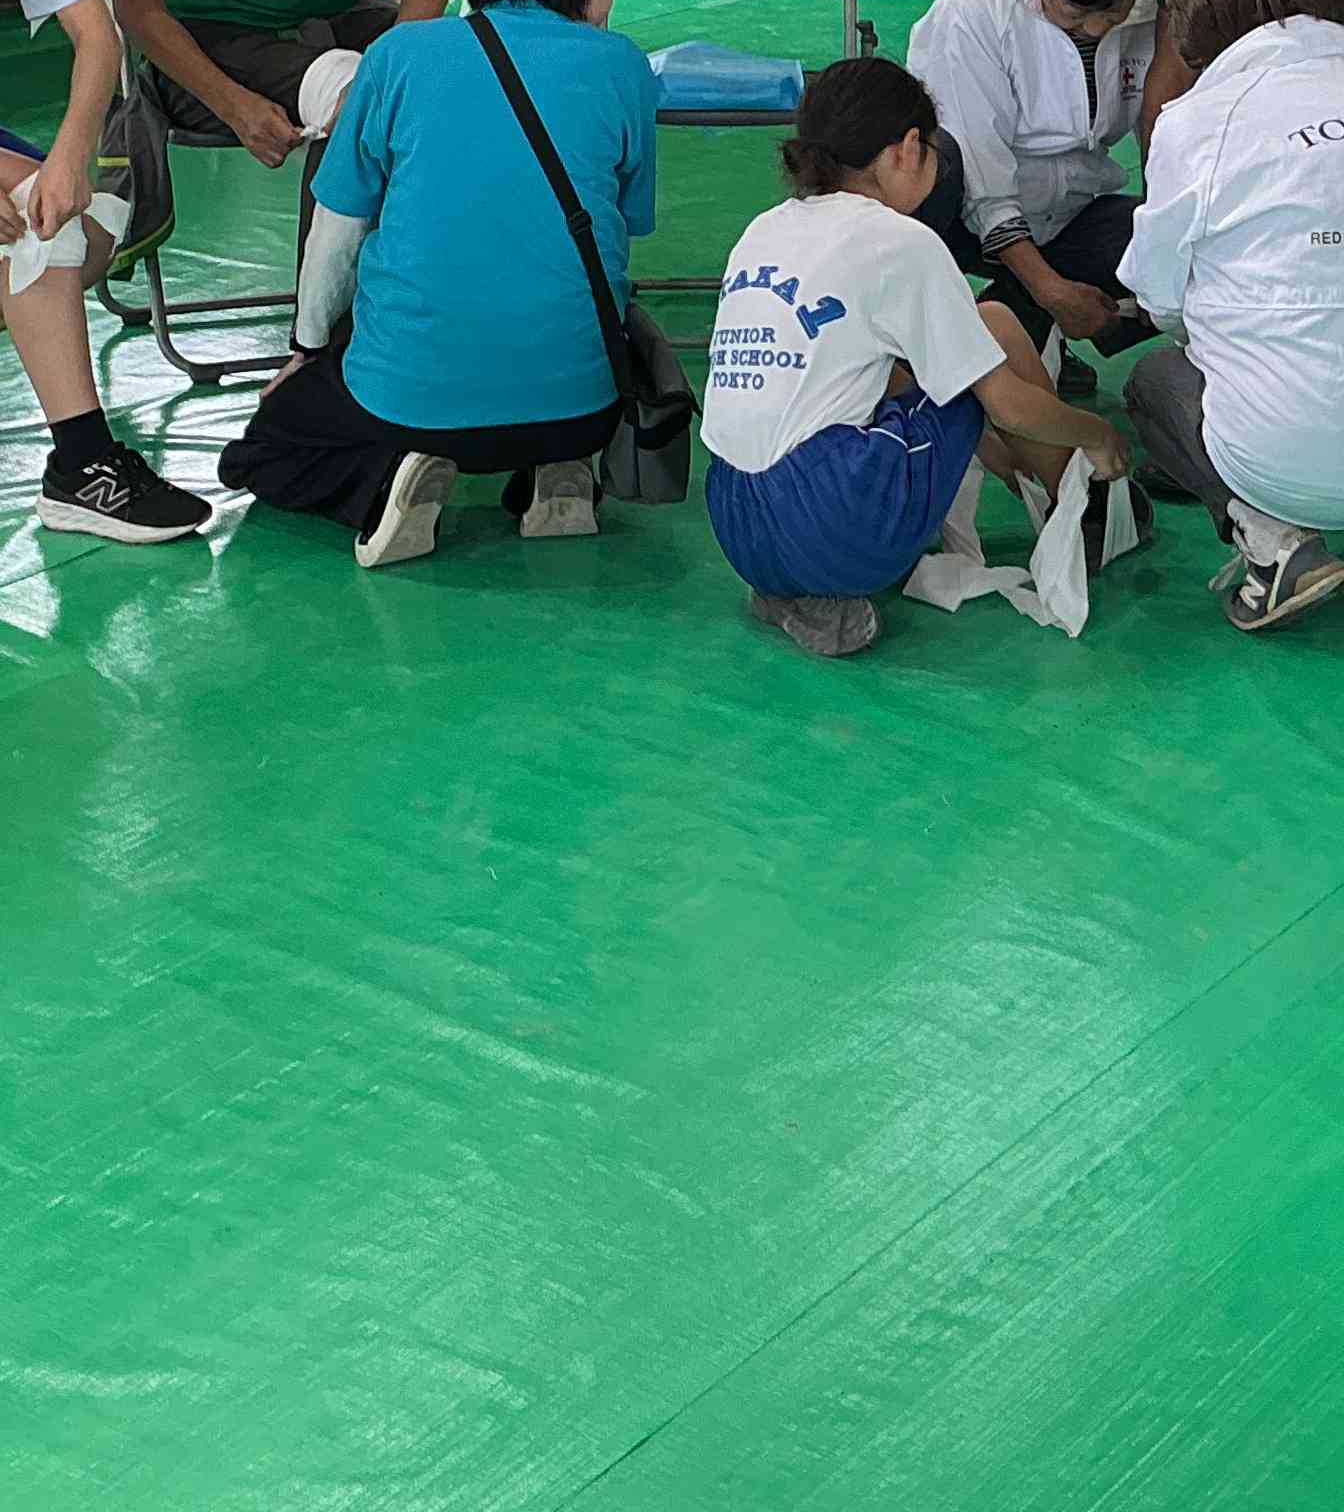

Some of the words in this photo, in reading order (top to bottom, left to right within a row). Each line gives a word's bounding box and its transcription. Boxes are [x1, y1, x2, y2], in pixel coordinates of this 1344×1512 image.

[1310, 231, 1342, 245] RED
[730, 349, 808, 370] SCHOOL
[713, 371, 765, 390] TOKYO
